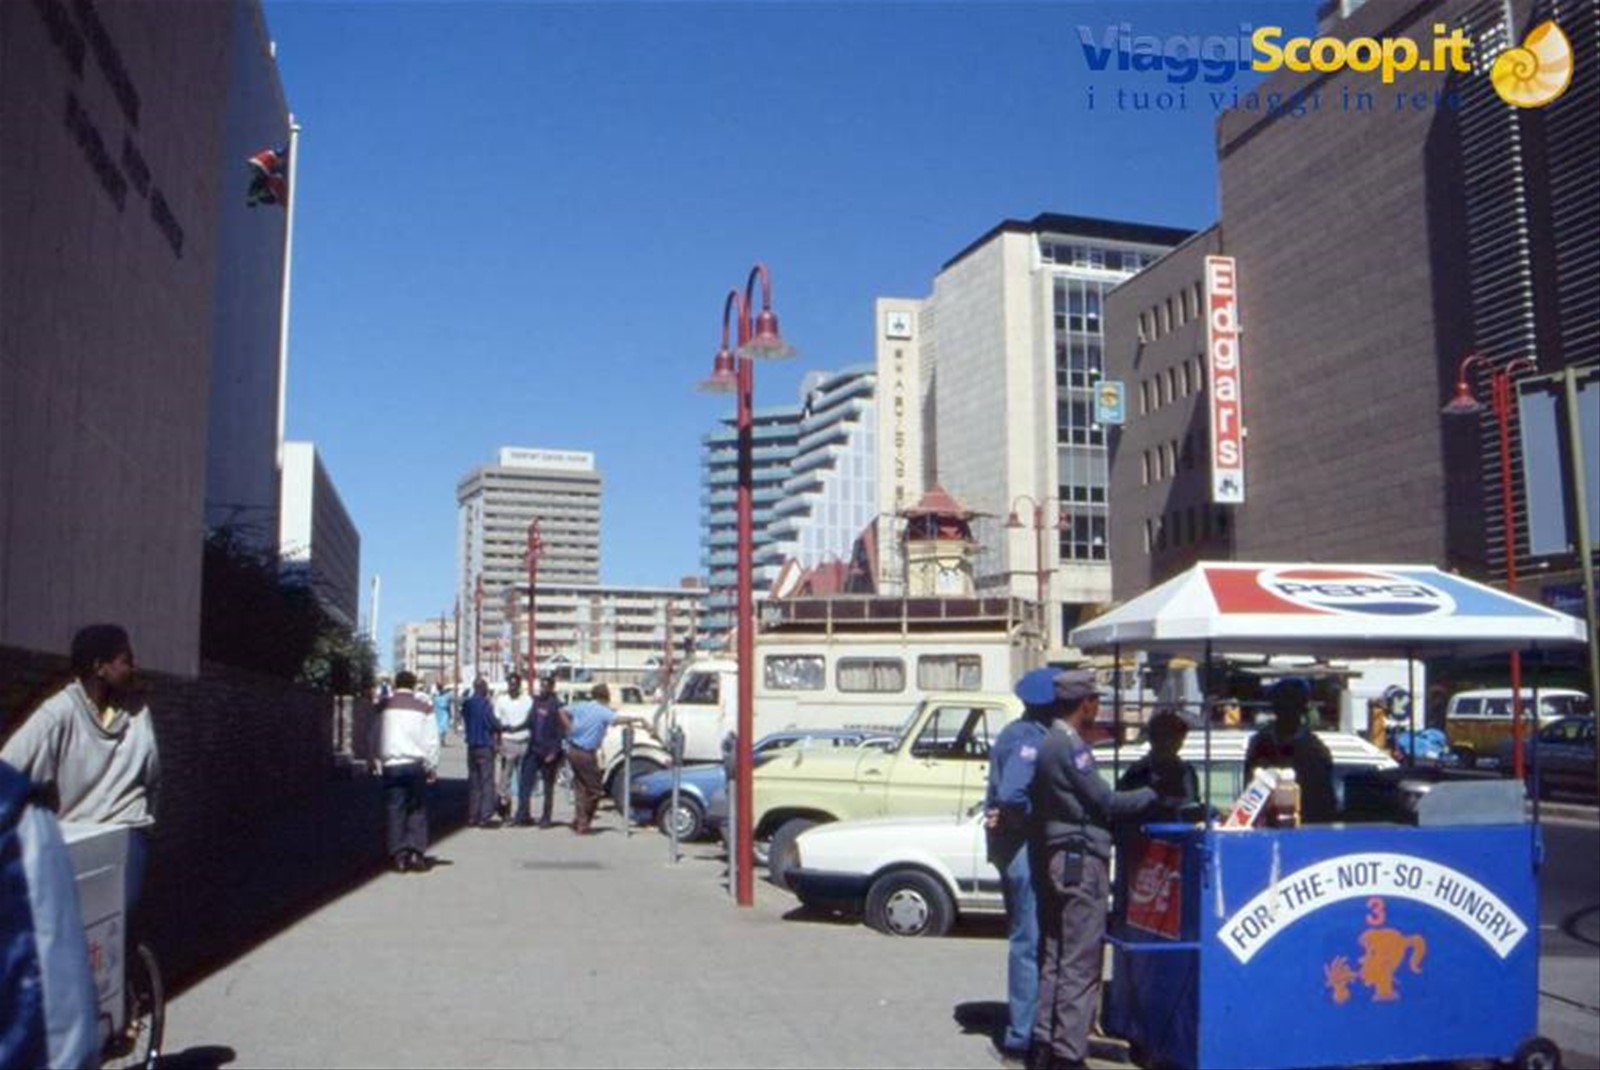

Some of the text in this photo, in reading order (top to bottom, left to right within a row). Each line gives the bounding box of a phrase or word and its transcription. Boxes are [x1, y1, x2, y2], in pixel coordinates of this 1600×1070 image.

[1211, 260, 1239, 466] Edgars
[1275, 583, 1438, 598] PEPSI
[1365, 895, 1387, 926] 3
